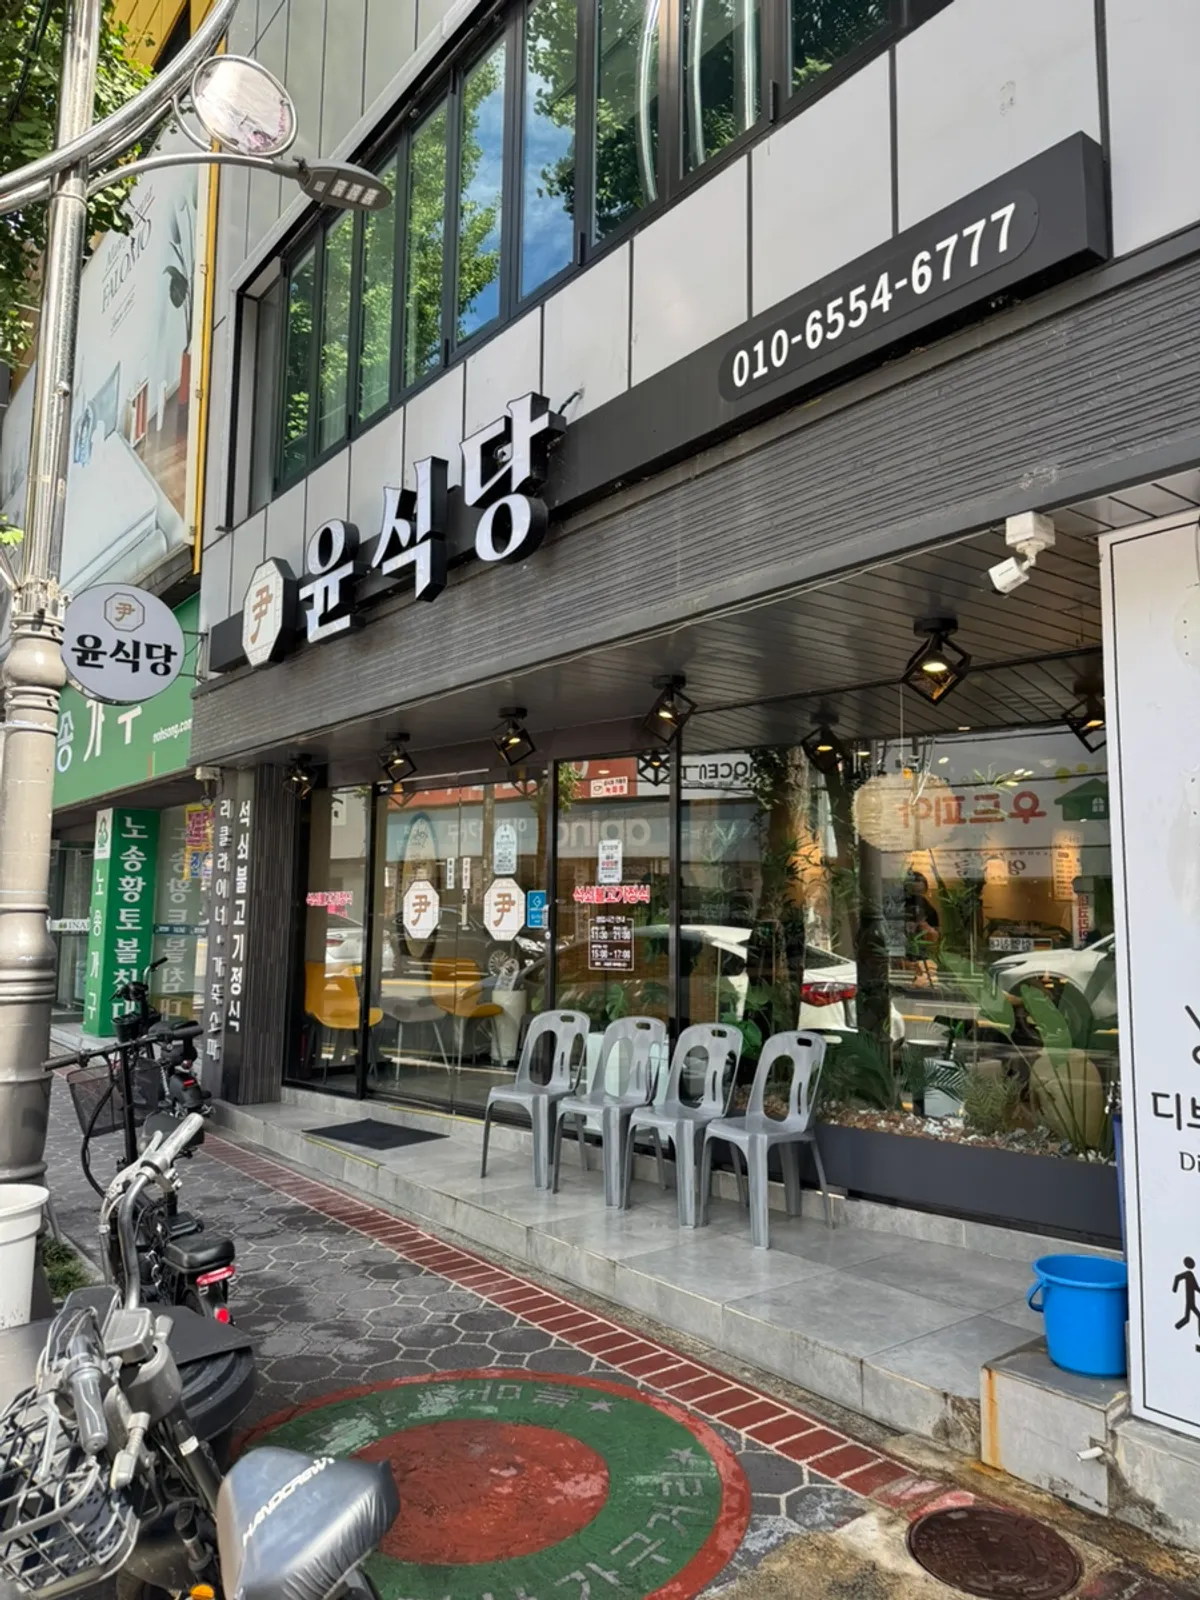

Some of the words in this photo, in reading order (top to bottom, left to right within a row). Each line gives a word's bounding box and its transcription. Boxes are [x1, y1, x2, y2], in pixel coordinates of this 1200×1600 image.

[732, 202, 1017, 389] 010-6554-6777
[299, 392, 551, 644] 윤식당
[71, 633, 178, 677] 윤식당
